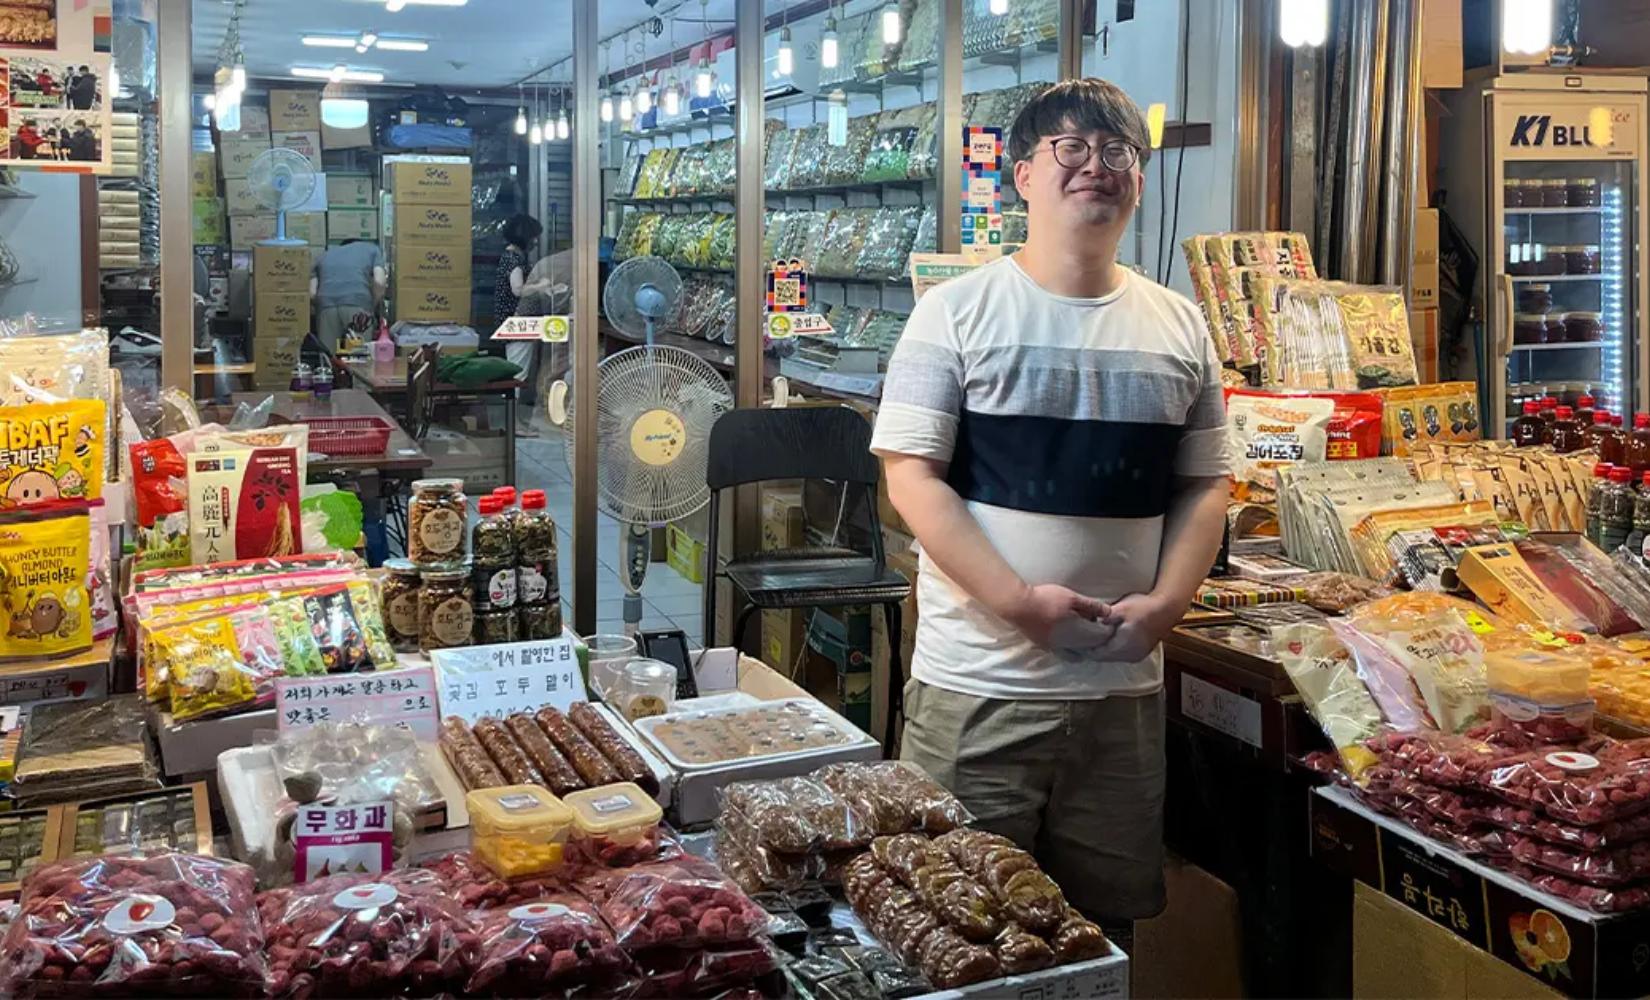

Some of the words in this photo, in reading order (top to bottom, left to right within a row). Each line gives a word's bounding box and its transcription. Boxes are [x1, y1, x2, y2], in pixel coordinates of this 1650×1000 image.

[1510, 115, 1551, 146] K1
[1553, 126, 1615, 146] BLU
[506, 320, 538, 332] 출입구
[794, 316, 821, 328] 출입구
[42, 546, 77, 557] BUTTER
[22, 559, 64, 575] ALMOND
[306, 805, 387, 833] 무화과
